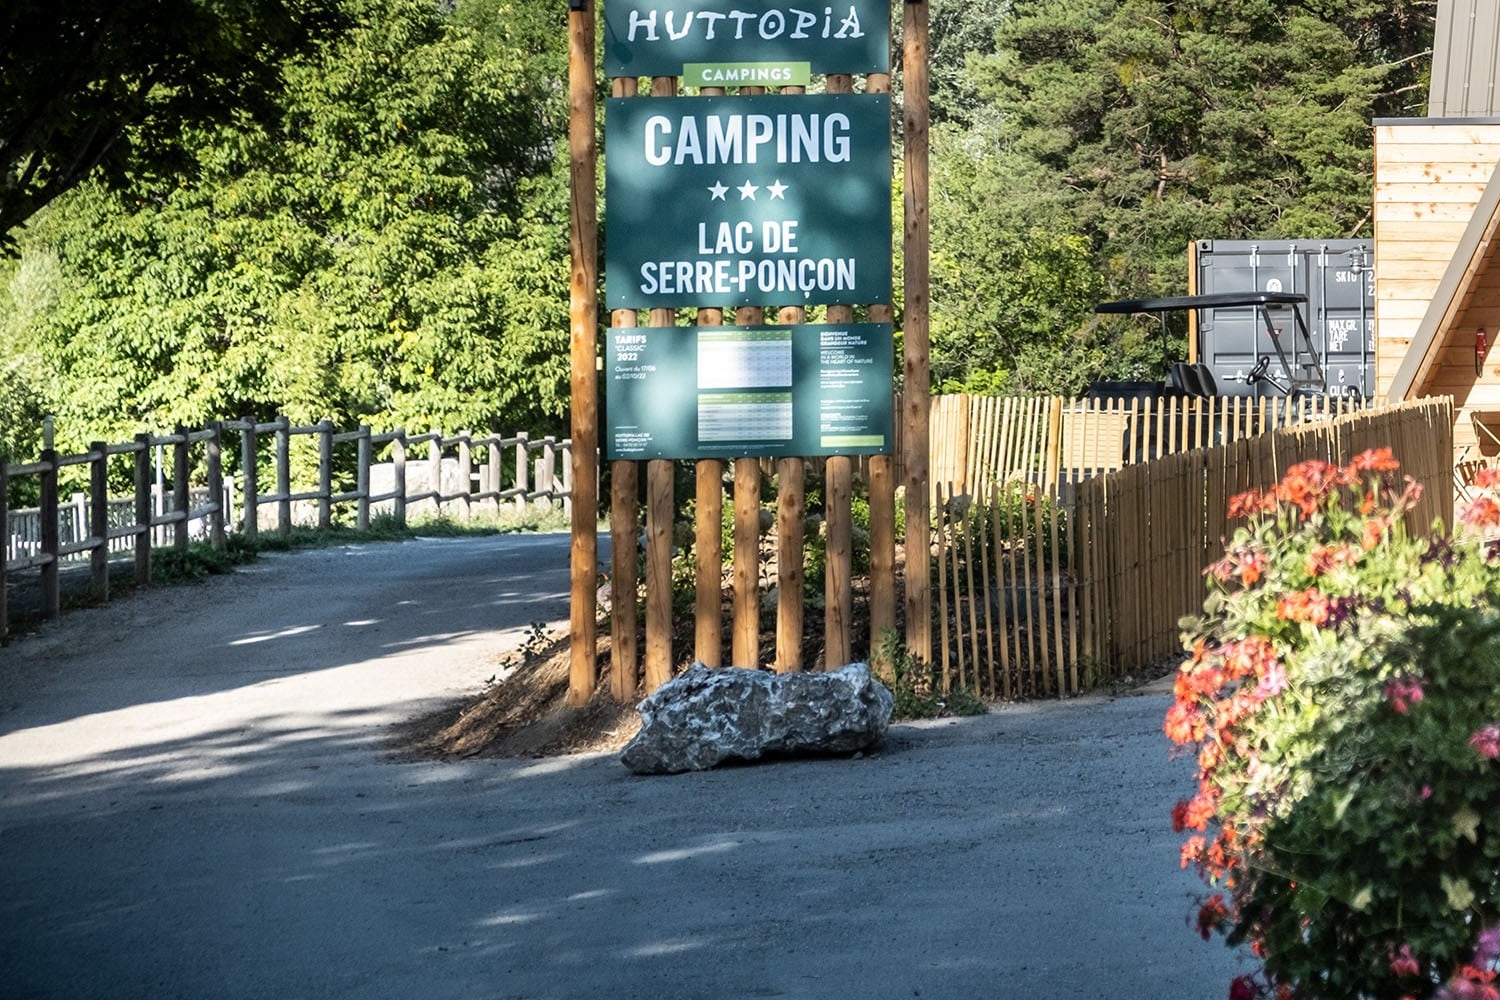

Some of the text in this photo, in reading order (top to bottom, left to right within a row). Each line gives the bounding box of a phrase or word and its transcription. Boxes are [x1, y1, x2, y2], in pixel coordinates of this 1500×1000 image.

[702, 68, 792, 81] CAMPINGS
[644, 113, 851, 167] CAMPING
[698, 220, 798, 255] LAC DE
[640, 258, 856, 298] SERRE-PONÇON
[615, 335, 647, 345] TARIFS
[617, 352, 638, 361] 2022
